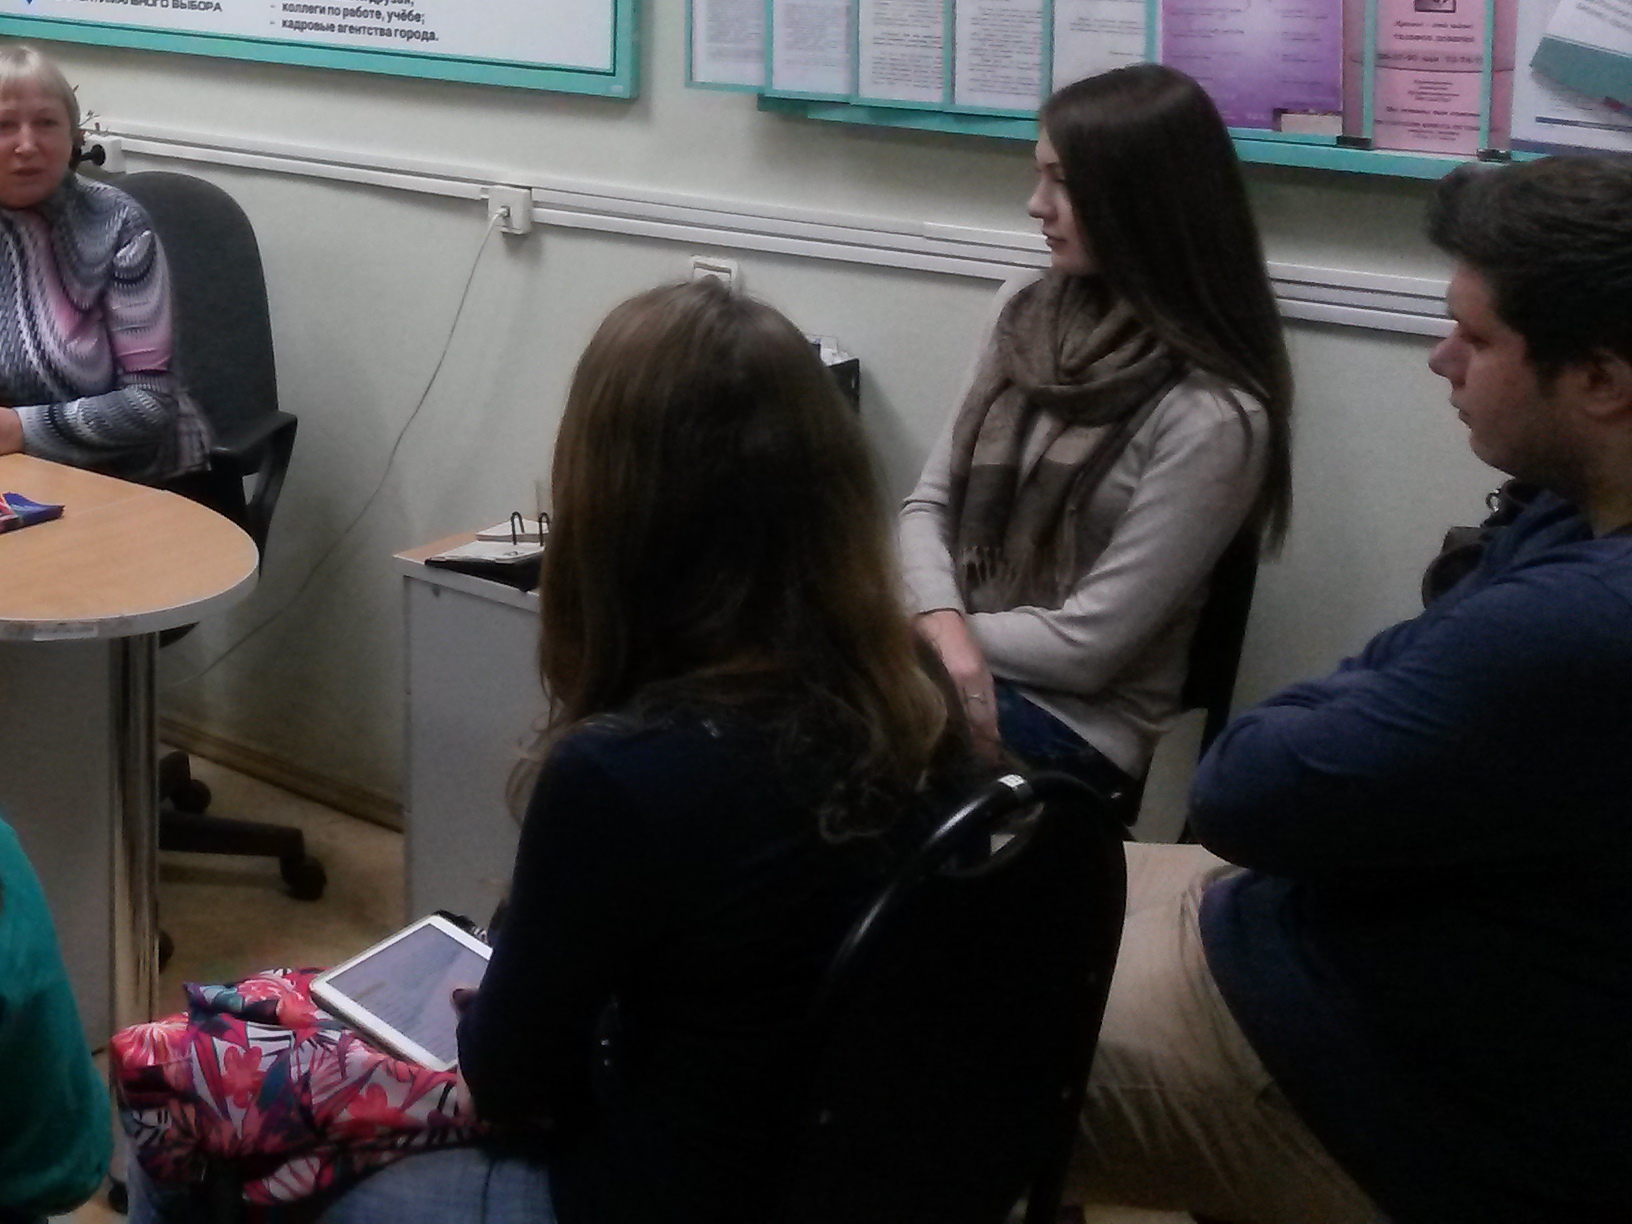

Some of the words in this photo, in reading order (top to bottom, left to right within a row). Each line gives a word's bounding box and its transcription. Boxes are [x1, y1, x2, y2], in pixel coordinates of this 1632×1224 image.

[172, 0, 223, 12] ВЫБОРА
[282, 2, 325, 15] коллеги
[328, 5, 340, 17] по
[342, 5, 384, 21] работе,
[338, 23, 392, 38] агентства
[394, 28, 438, 42] города.
